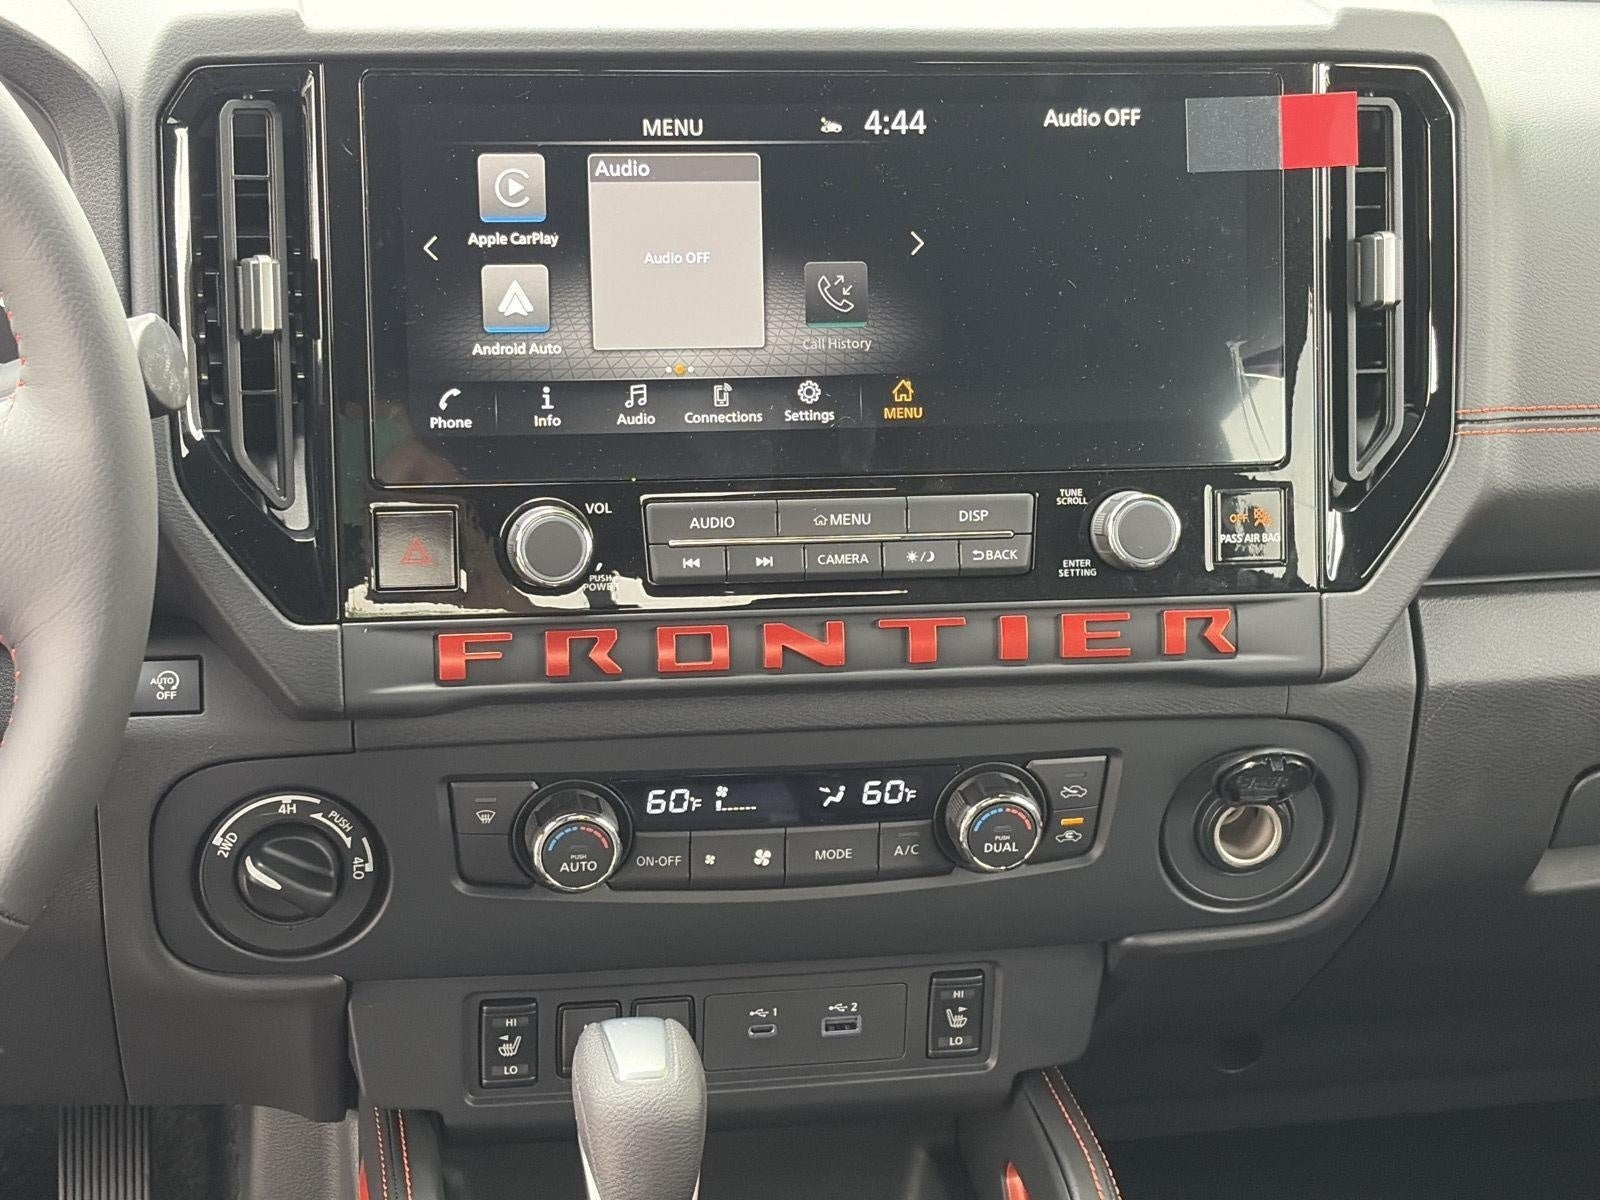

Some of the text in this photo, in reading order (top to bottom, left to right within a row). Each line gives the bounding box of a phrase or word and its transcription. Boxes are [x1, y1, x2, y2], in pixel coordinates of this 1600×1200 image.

[863, 109, 928, 136] 4:44
[1043, 107, 1142, 128] Audio OFF
[642, 118, 703, 137] MENU
[594, 159, 651, 178] Audio
[467, 231, 560, 249] Apple CarPlay
[643, 251, 712, 265] Audio OFF
[472, 342, 563, 357] Android Auto
[802, 336, 872, 353] Call History
[684, 410, 763, 426] Connections
[784, 408, 835, 425] Settings
[883, 405, 923, 420] MENU
[429, 415, 473, 431] Phone
[533, 413, 562, 429] Info
[616, 412, 657, 427] Audio
[1059, 488, 1084, 498] TUNE
[1056, 496, 1088, 507] SCROLL
[585, 502, 613, 515] VOL
[689, 516, 736, 530] AUDIO
[830, 513, 872, 527] MENU
[958, 510, 989, 523] DISP
[1229, 513, 1250, 524] OFF
[1220, 532, 1281, 544] PASS AIR BAG
[817, 553, 870, 566] CAMERA
[985, 549, 1019, 561] BACK
[1062, 559, 1092, 569] ENTER
[589, 574, 613, 582] PUSH
[1058, 567, 1098, 578] SETTING
[583, 582, 619, 592] POWE
[437, 608, 1237, 681] FRONTIER
[149, 676, 175, 686] AUTO
[156, 691, 177, 701] OFF
[278, 803, 297, 815] 4H
[327, 810, 354, 833] PUSH
[217, 831, 239, 859] 2WD
[894, 844, 920, 857] A/C
[983, 842, 1019, 853] DUAL
[570, 853, 587, 861] PUSH
[814, 848, 853, 861] MODE
[351, 856, 365, 881] 4LO
[559, 860, 598, 874] AUTO
[952, 990, 965, 999] HI
[850, 1001, 858, 1012] 2
[505, 1018, 518, 1028] HI
[949, 1036, 964, 1046] LO
[503, 1065, 519, 1076] LO
